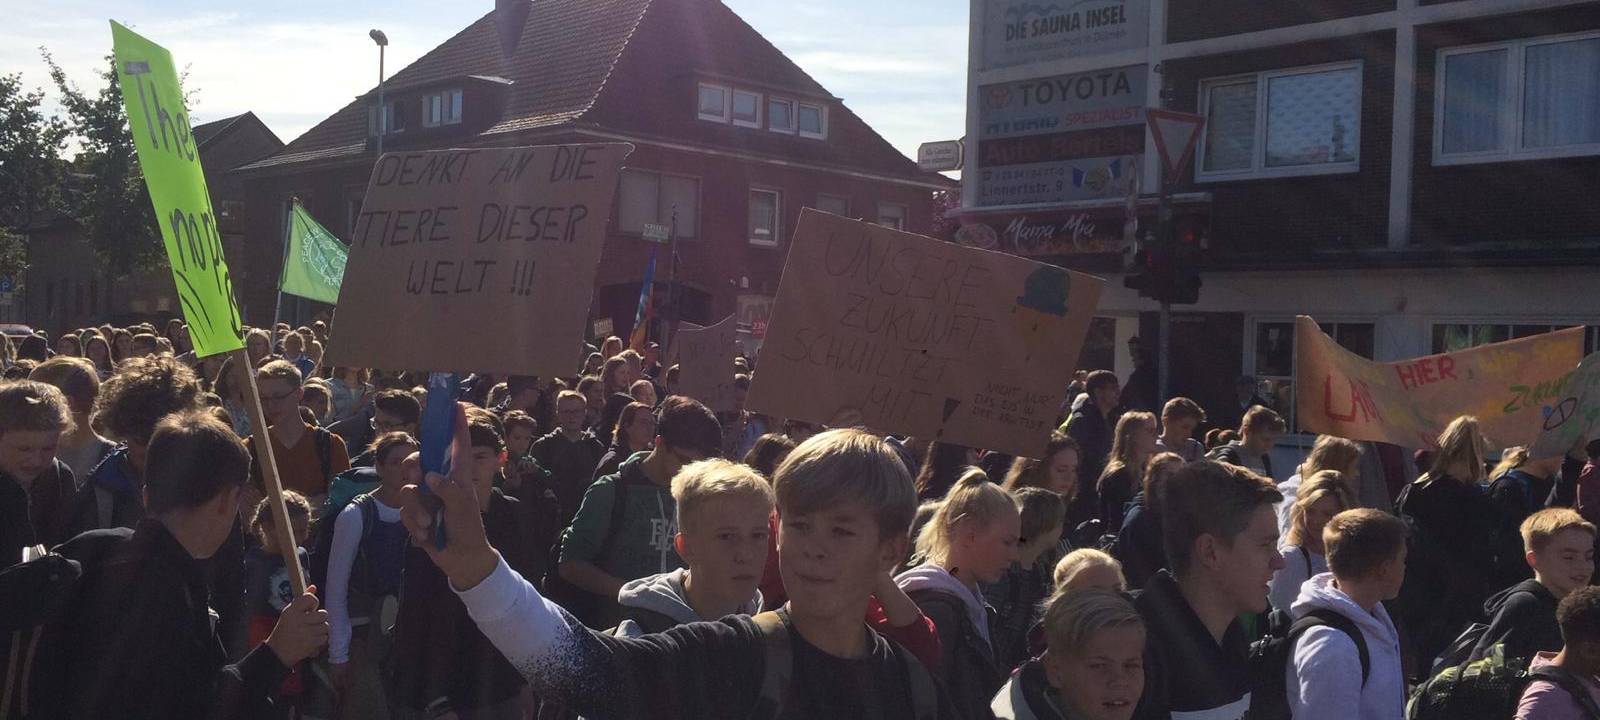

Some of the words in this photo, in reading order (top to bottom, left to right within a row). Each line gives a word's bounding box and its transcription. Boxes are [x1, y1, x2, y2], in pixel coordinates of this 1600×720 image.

[1006, 21, 1027, 42] DIE
[1031, 12, 1081, 38] SAUNA
[1086, 4, 1126, 29] INSEL
[1017, 71, 1131, 107] TOYOTA
[376, 150, 480, 186] DENKT
[489, 151, 534, 184] AN
[549, 145, 605, 183] DIE
[360, 207, 458, 248] TIERE
[476, 203, 589, 244] DIESER
[1003, 216, 1056, 243] Mama
[1062, 213, 1097, 242] Mia
[406, 259, 497, 296] WELT
[510, 259, 536, 297] !!!
[825, 231, 991, 309] UNSERE
[839, 292, 996, 349] ZUKUNFT
[1393, 355, 1458, 391] HIER
